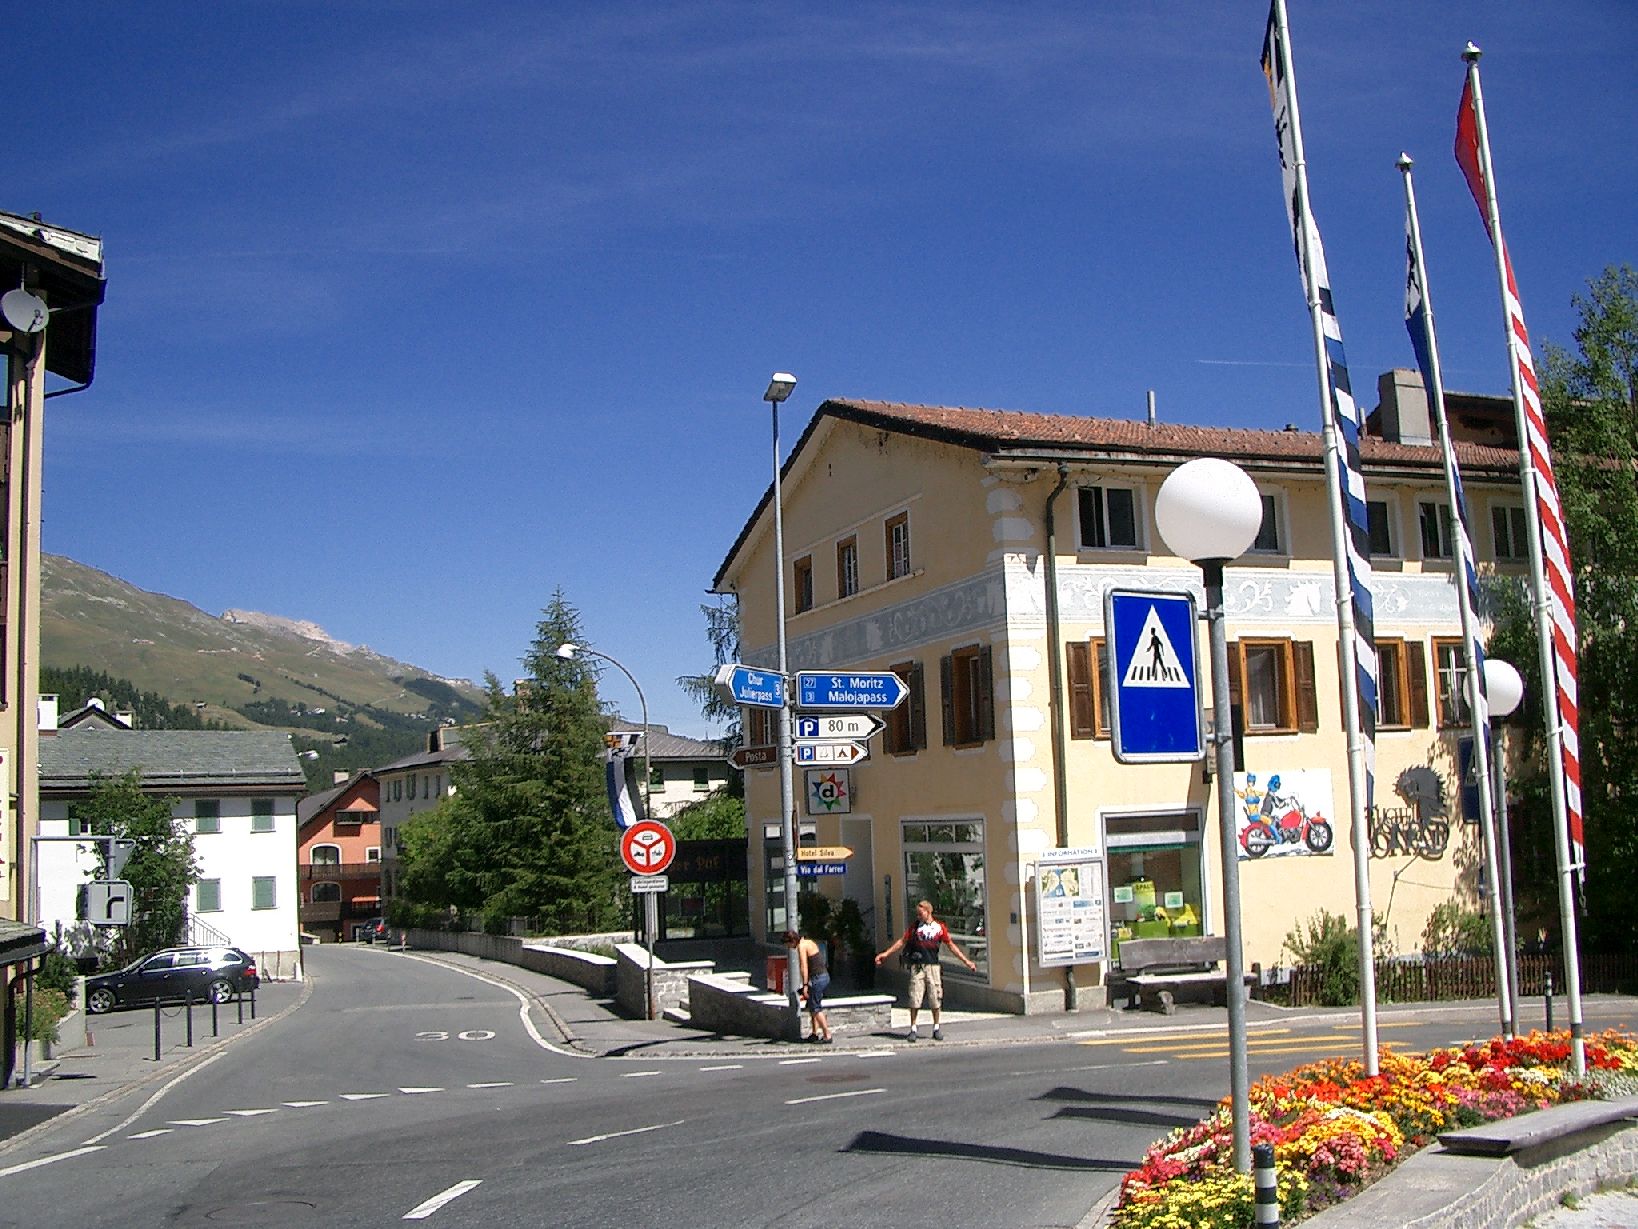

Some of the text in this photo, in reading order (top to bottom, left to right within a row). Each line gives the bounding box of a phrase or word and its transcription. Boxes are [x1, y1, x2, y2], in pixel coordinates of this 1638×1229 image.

[747, 672, 763, 685] Chur
[831, 677, 884, 689] St. Moritz
[740, 686, 773, 701] Julierpass
[828, 690, 888, 704] Malojapass
[803, 721, 814, 736] P
[828, 720, 859, 732] 80 m
[745, 751, 767, 762] Posta
[803, 747, 811, 759] P
[416, 1030, 496, 1041] 30
